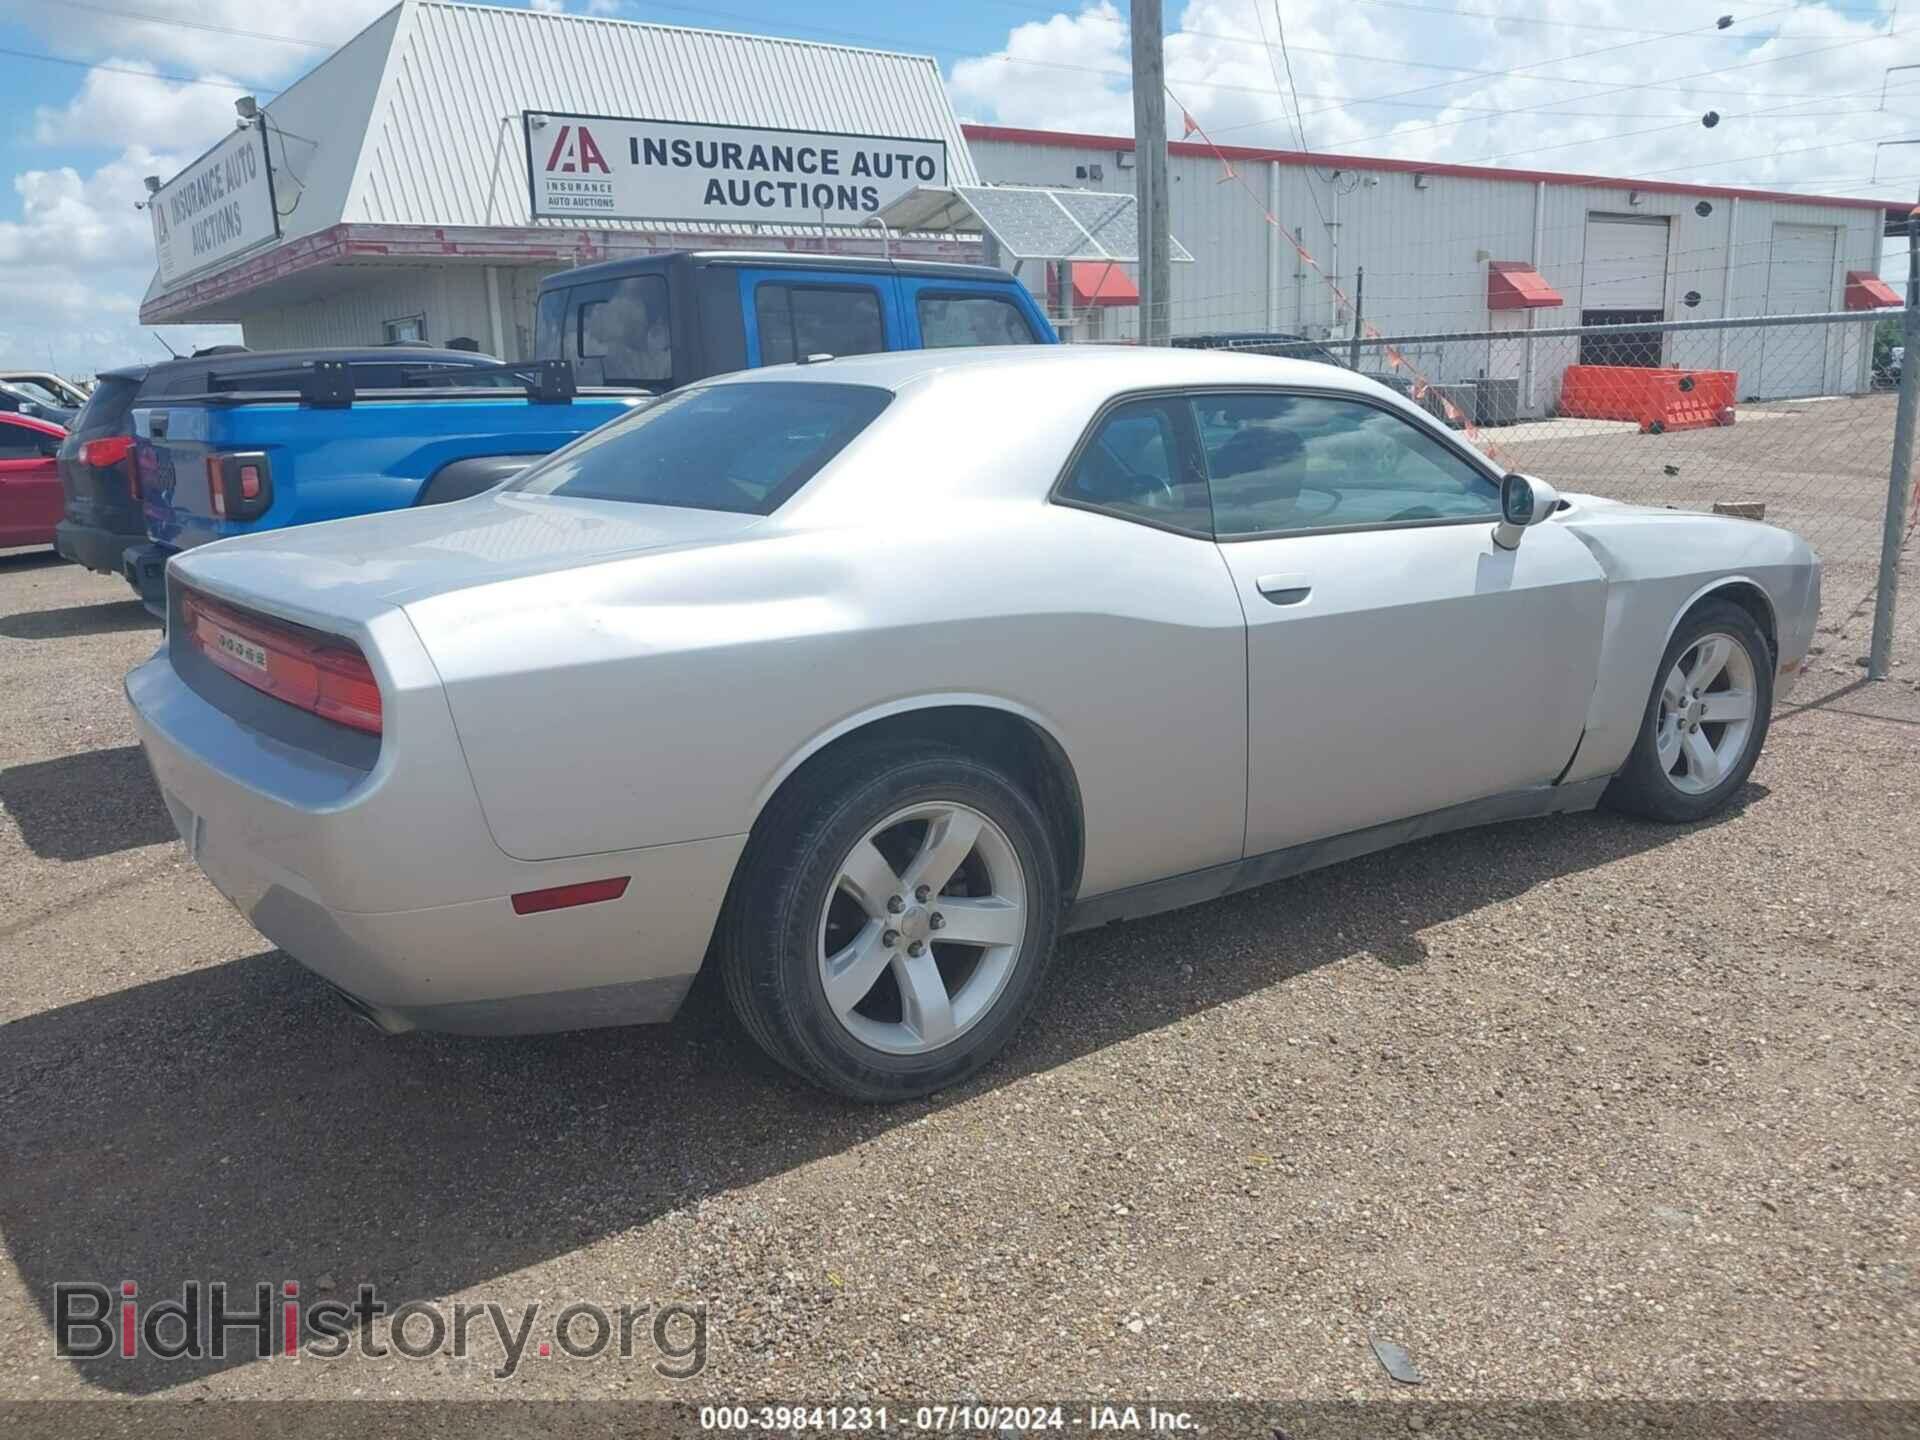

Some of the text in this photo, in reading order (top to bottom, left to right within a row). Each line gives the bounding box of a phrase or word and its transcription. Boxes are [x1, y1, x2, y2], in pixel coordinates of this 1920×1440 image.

[629, 136, 936, 181] INSURANCE AUTO
[171, 141, 257, 225] INSURANCE AUTO
[546, 181, 612, 193] INSURANCE
[548, 196, 614, 208] AUTO AUCTIONS
[704, 178, 880, 212] AUCTIONS
[191, 201, 243, 256] AUCTIONS
